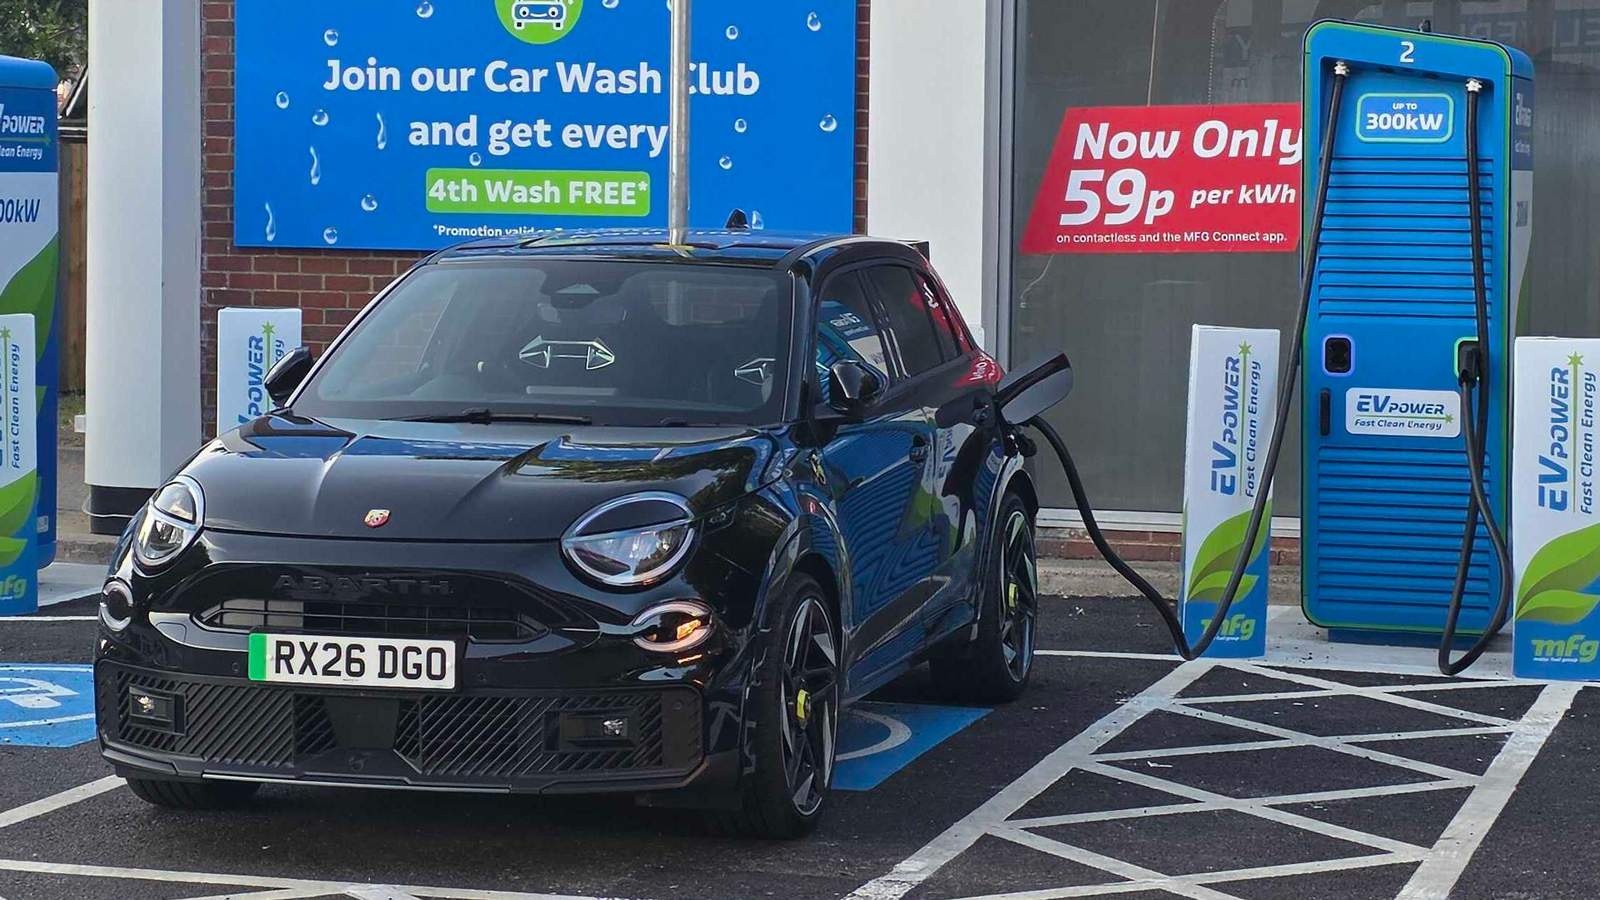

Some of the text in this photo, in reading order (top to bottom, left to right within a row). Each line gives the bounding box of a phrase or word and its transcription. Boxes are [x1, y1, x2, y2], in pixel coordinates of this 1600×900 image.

[1400, 41, 1415, 63] 2
[323, 57, 400, 91] Join
[411, 67, 475, 92] our
[484, 60, 548, 92] Car
[556, 62, 661, 94] Wash
[1366, 113, 1443, 130] 300kW
[408, 115, 668, 158] and get every
[1073, 119, 1302, 165] Now Only
[16, 145, 43, 160] Energy
[428, 178, 477, 202] 4th
[484, 179, 560, 204] Wash
[1059, 168, 1296, 226] 59p per kWh
[1056, 231, 1287, 244] on contactless and the MFG Connect app.
[10, 343, 20, 469] Fast Clean Energy
[1245, 361, 1261, 498] Fast Clean Energy
[1377, 419, 1405, 428] Clean
[1408, 421, 1442, 430] Energy
[1580, 372, 1596, 515] Fast Clean Energy
[0, 574, 27, 599] fg
[272, 573, 452, 596] ABARTH
[275, 640, 447, 681] RX26 DGO
[1531, 634, 1599, 663] mfg
